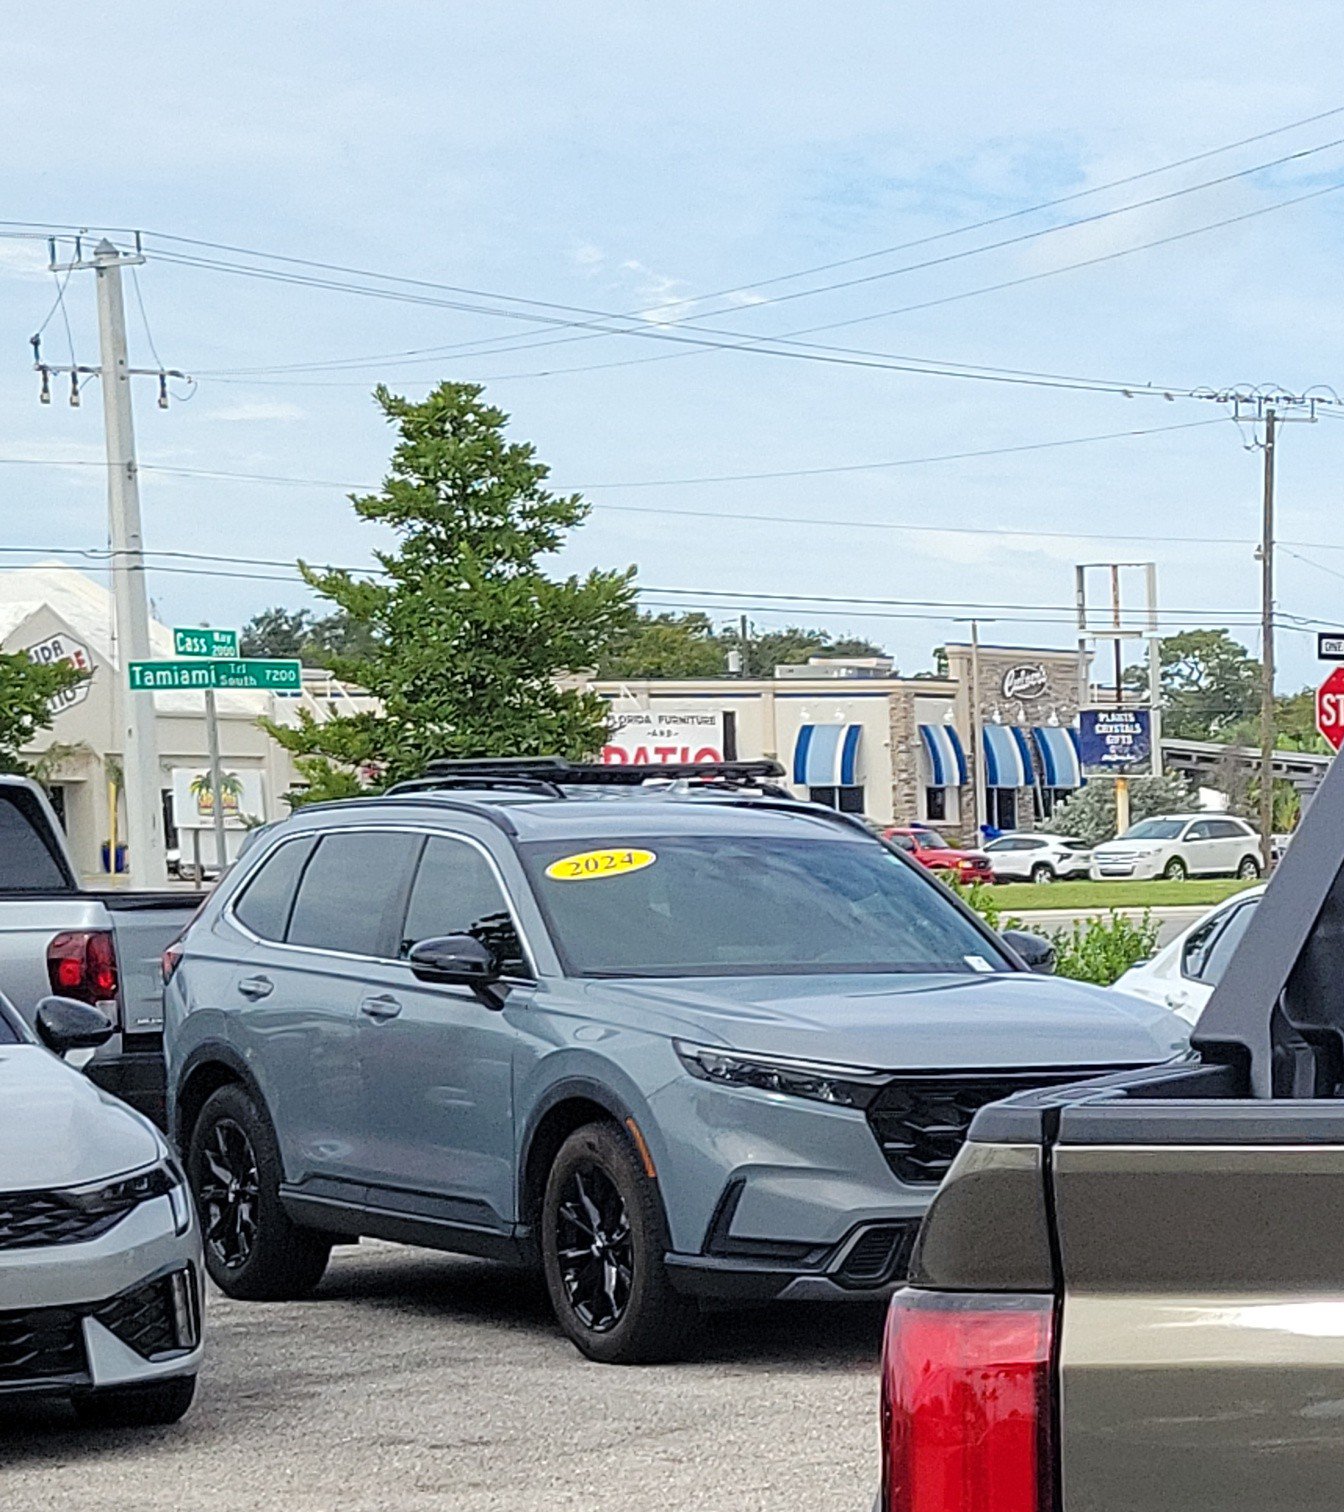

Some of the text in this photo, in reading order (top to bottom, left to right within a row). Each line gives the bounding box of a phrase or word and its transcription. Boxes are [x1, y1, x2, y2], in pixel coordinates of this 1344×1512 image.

[176, 632, 232, 653] Cass Way
[1325, 641, 1343, 652] ONE
[132, 665, 215, 686] Tamiami
[220, 674, 257, 687] South
[265, 669, 297, 682] 7200
[658, 715, 716, 725] FURNITURE
[567, 852, 633, 877] 2024
